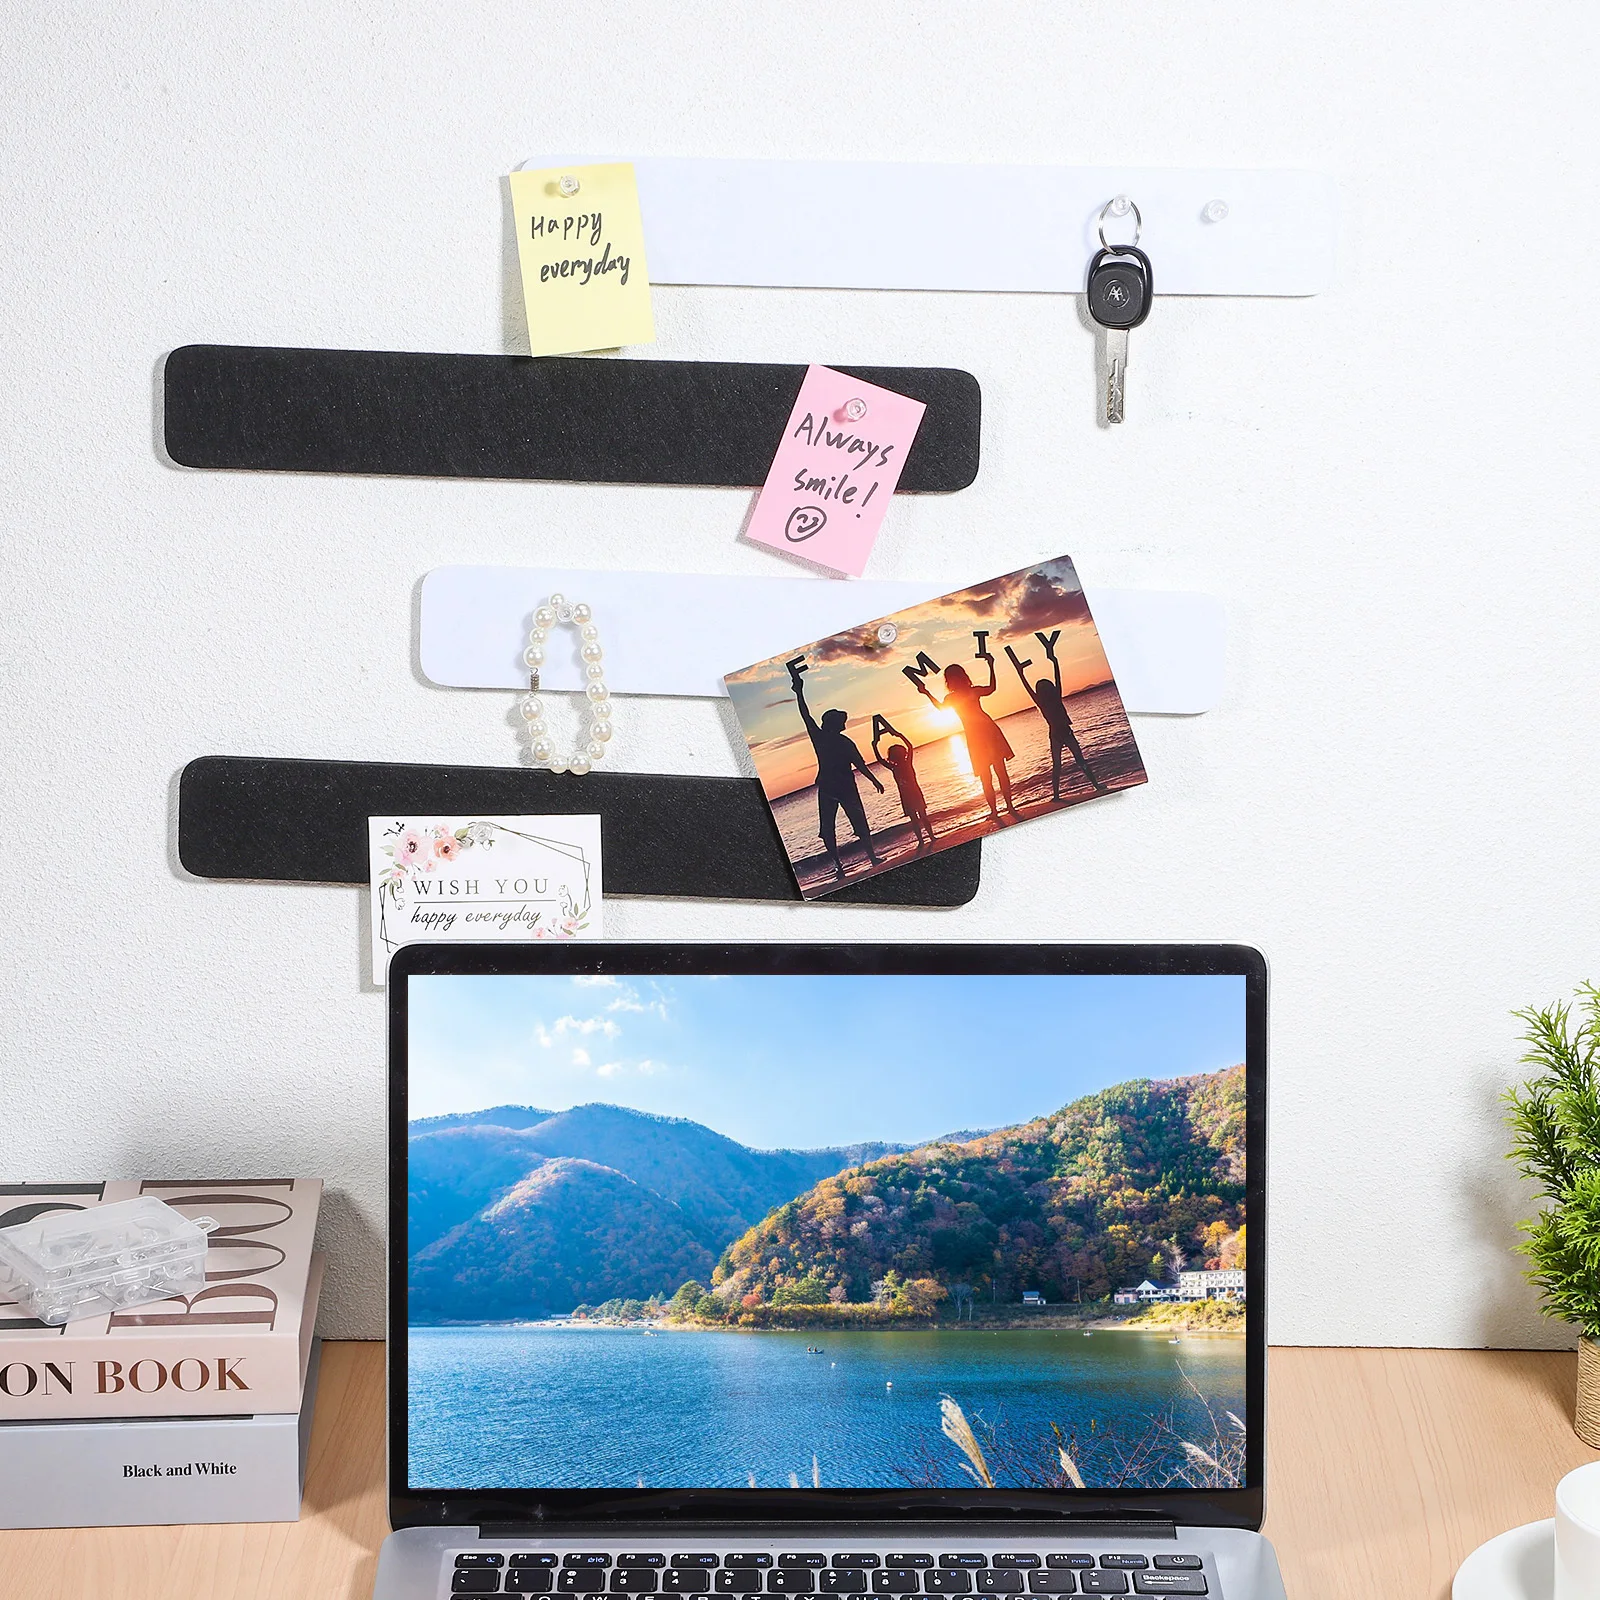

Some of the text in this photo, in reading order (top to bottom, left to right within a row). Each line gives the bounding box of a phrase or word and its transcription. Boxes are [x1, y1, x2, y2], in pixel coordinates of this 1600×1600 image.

[531, 212, 602, 246] Happy
[540, 243, 630, 286] everyday
[794, 412, 895, 471] Always
[794, 468, 879, 519] smile!
[413, 878, 549, 896] WISH YOU
[410, 904, 542, 931] happy everyday
[0, 1357, 253, 1397] ON BOOK
[122, 1462, 237, 1479] Black and White
[1142, 1574, 1190, 1582] Backspace
